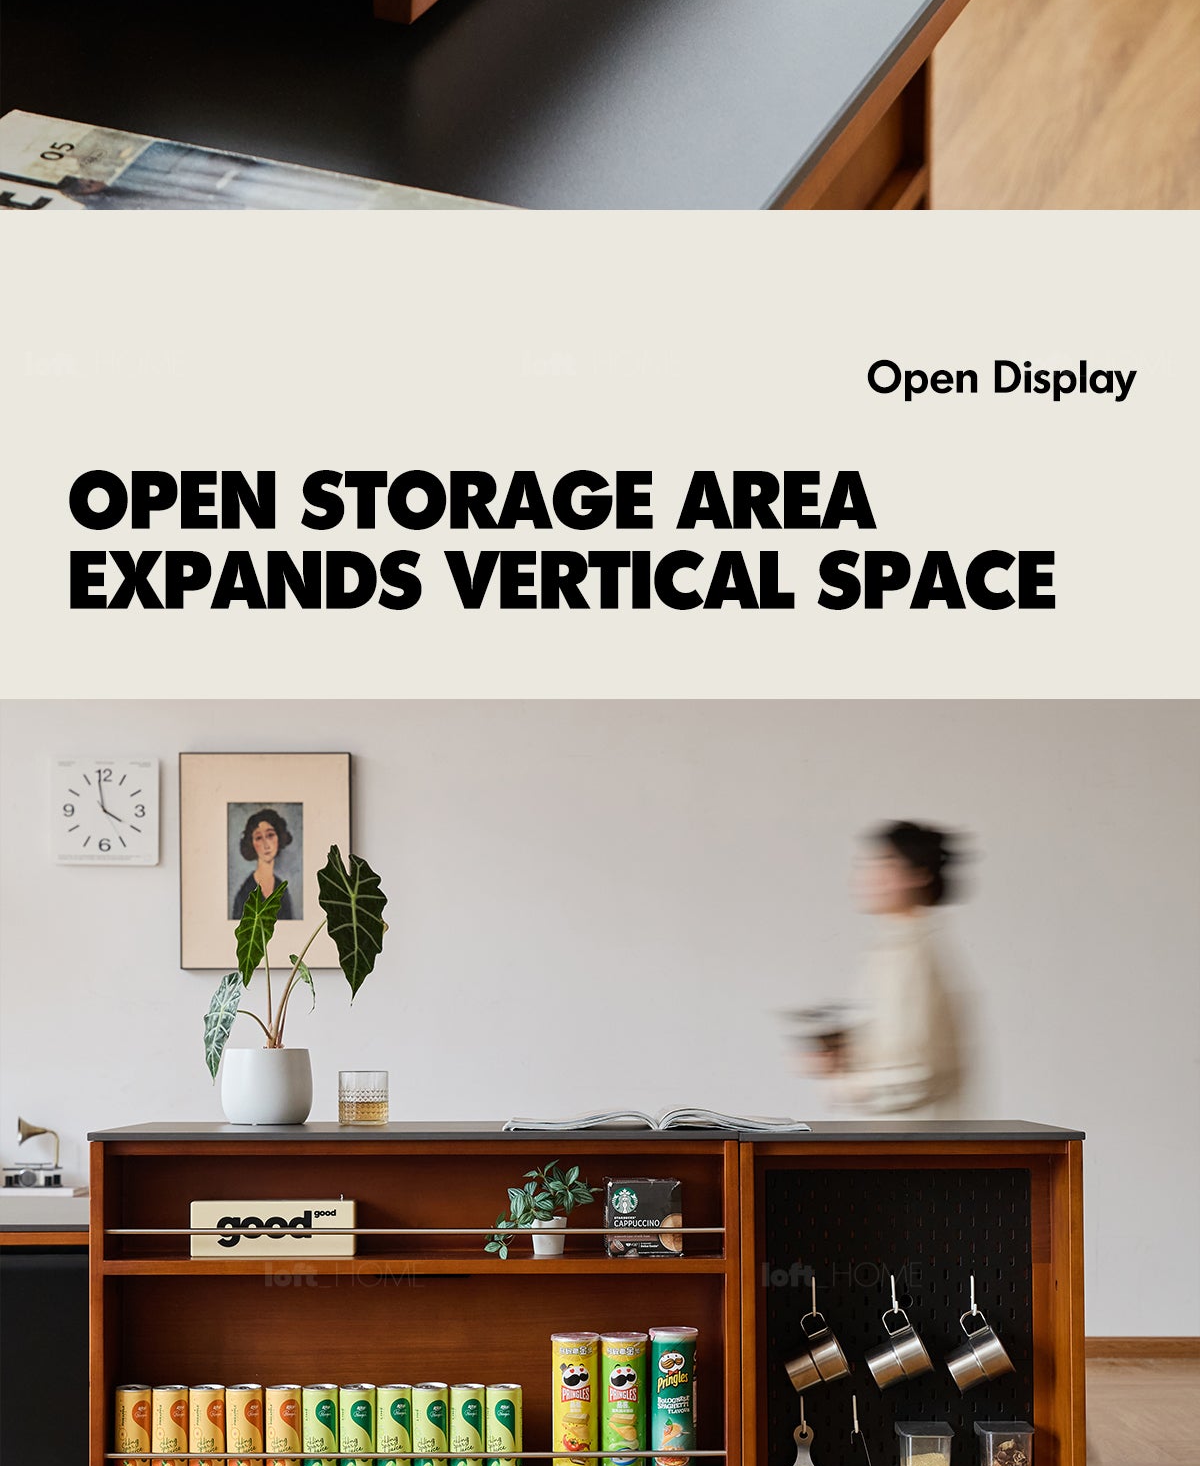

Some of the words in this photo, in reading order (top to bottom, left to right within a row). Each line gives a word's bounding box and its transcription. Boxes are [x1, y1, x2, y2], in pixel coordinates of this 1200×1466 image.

[95, 768, 113, 782] 12
[63, 803, 75, 817] 9
[134, 804, 146, 818] 3
[98, 838, 111, 852] 6
[314, 1209, 336, 1218] good
[217, 1210, 312, 1247] good
[613, 1219, 660, 1227] CAPPUCCINO
[657, 1372, 688, 1393] Pringles
[562, 1387, 589, 1401] PRINGLES
[610, 1387, 636, 1401] PRINGLES
[657, 1401, 689, 1410] SPAGHETTI
